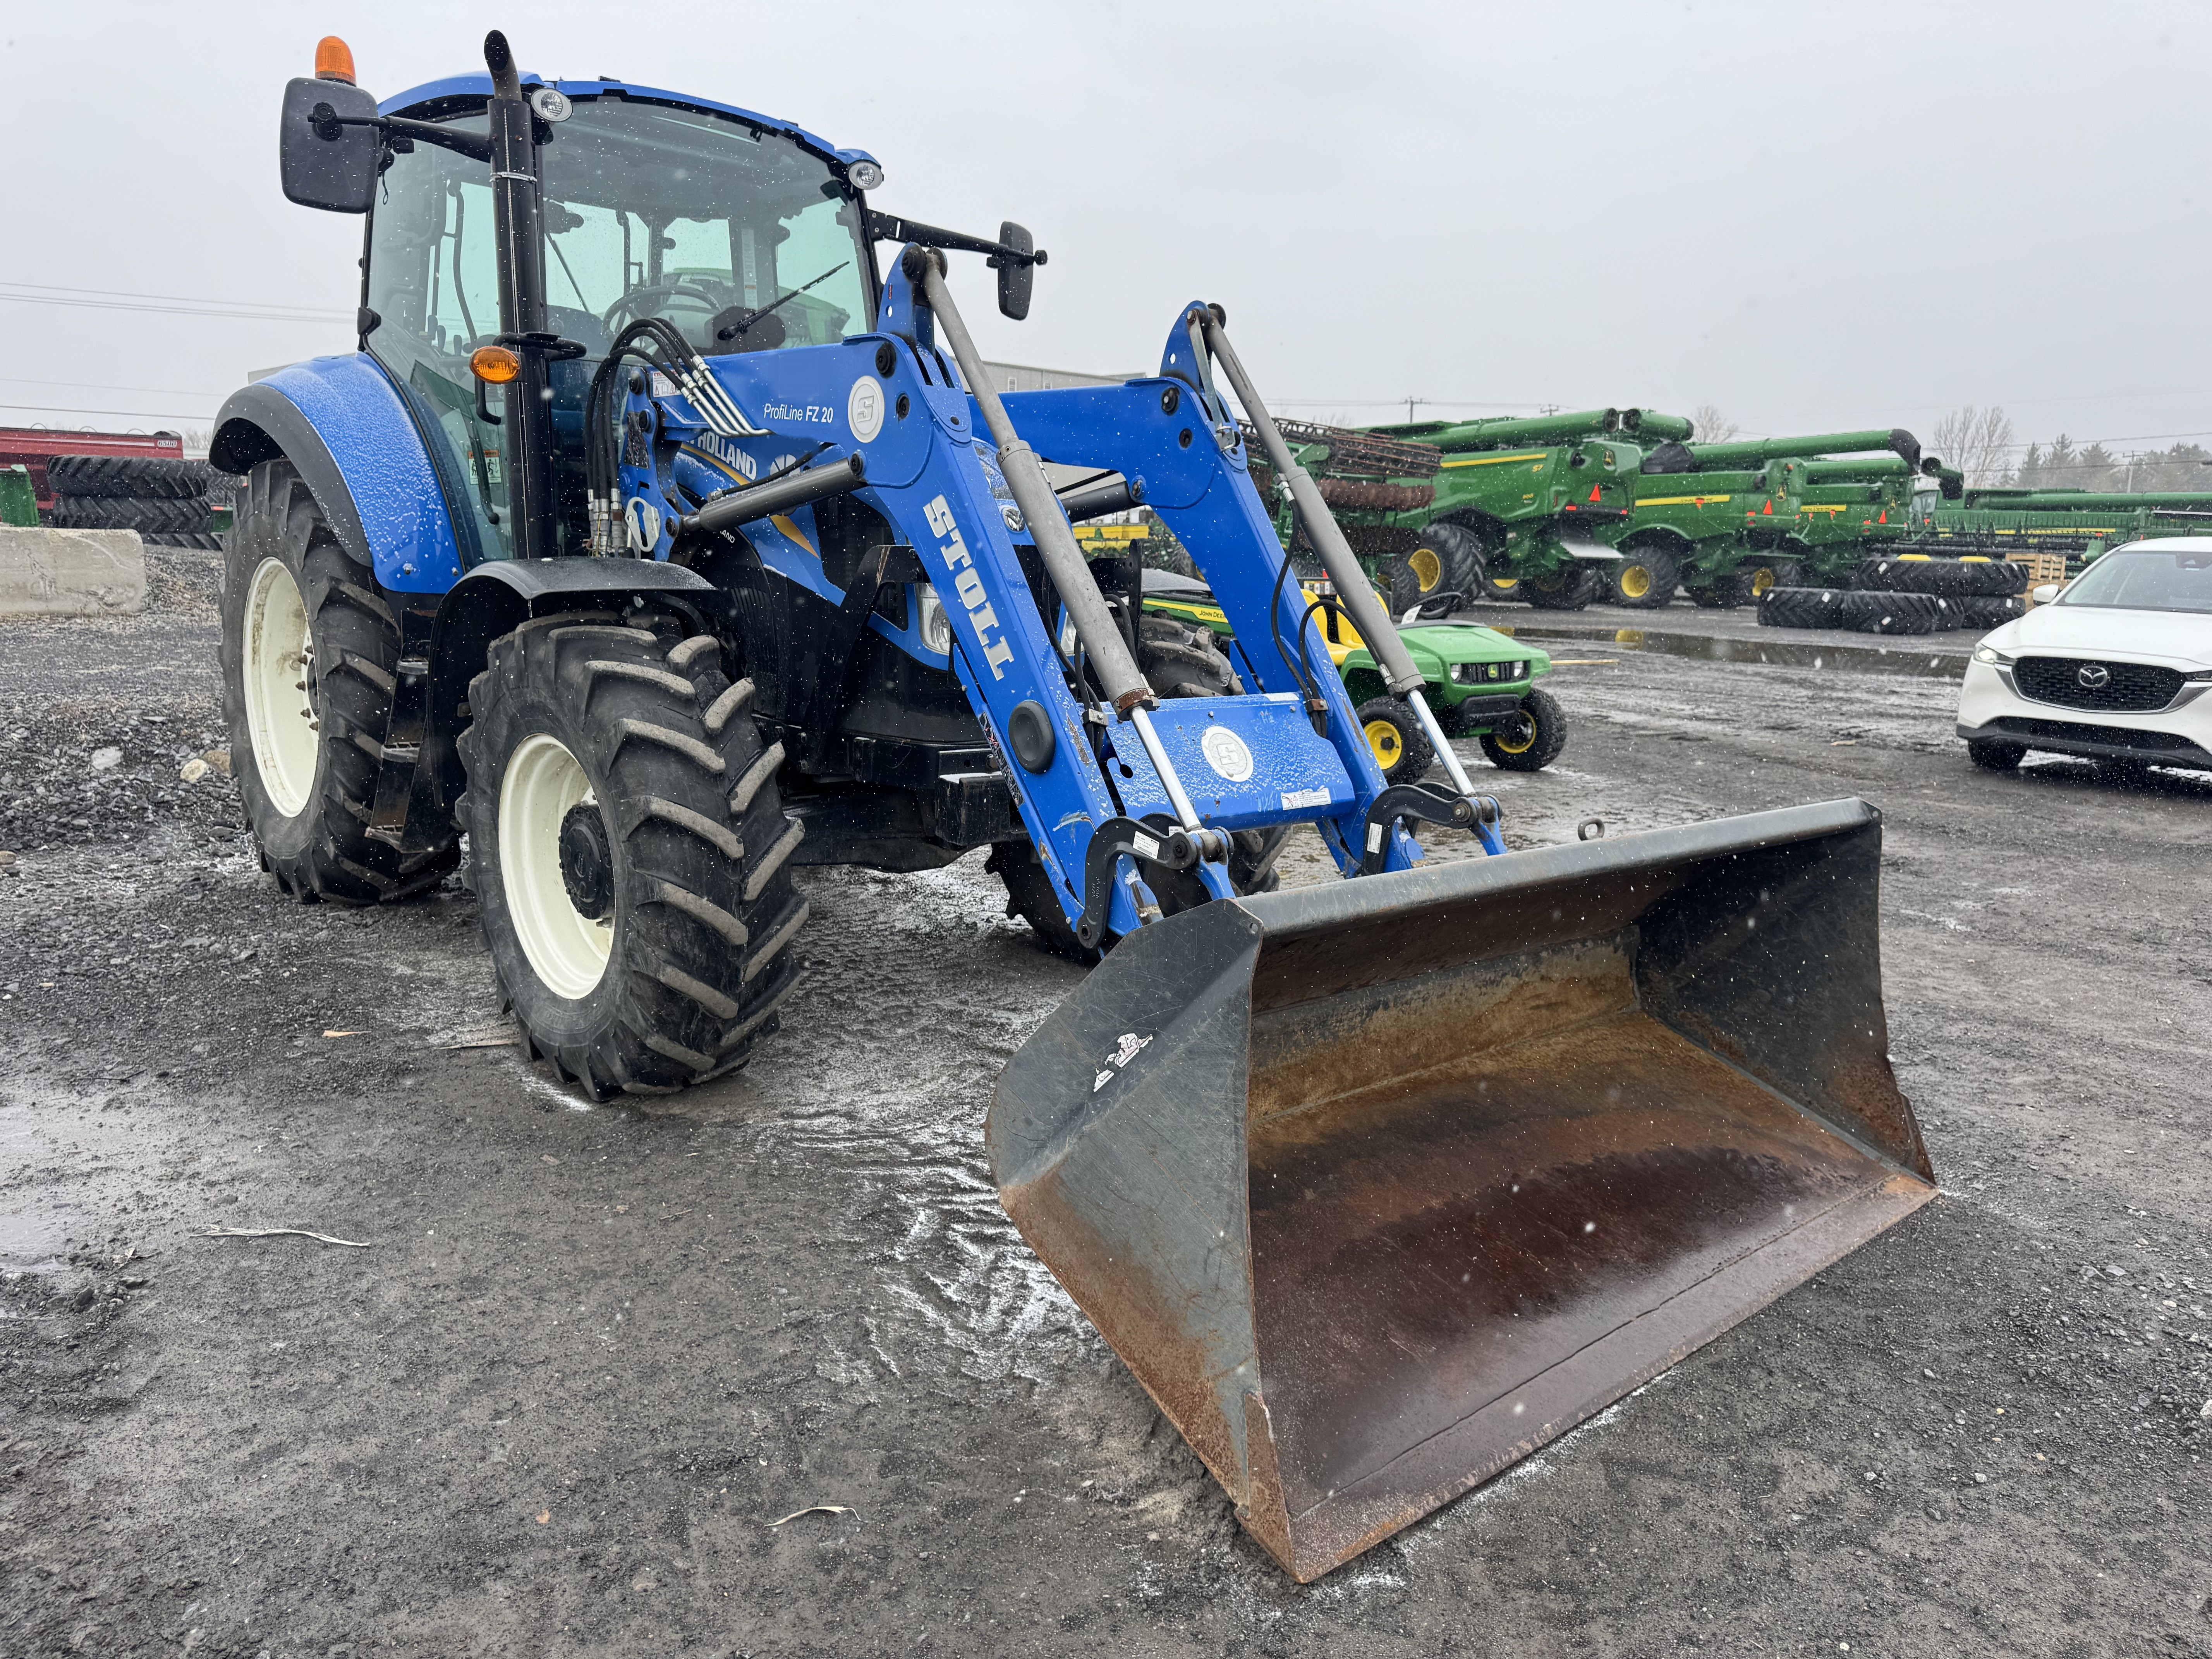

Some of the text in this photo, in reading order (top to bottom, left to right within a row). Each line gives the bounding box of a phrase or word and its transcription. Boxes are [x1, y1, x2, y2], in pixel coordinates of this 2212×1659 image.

[764, 403, 833, 423] ProfiLine FZ 20
[697, 431, 757, 480] HOLLAND
[923, 494, 1015, 681] STOLL
